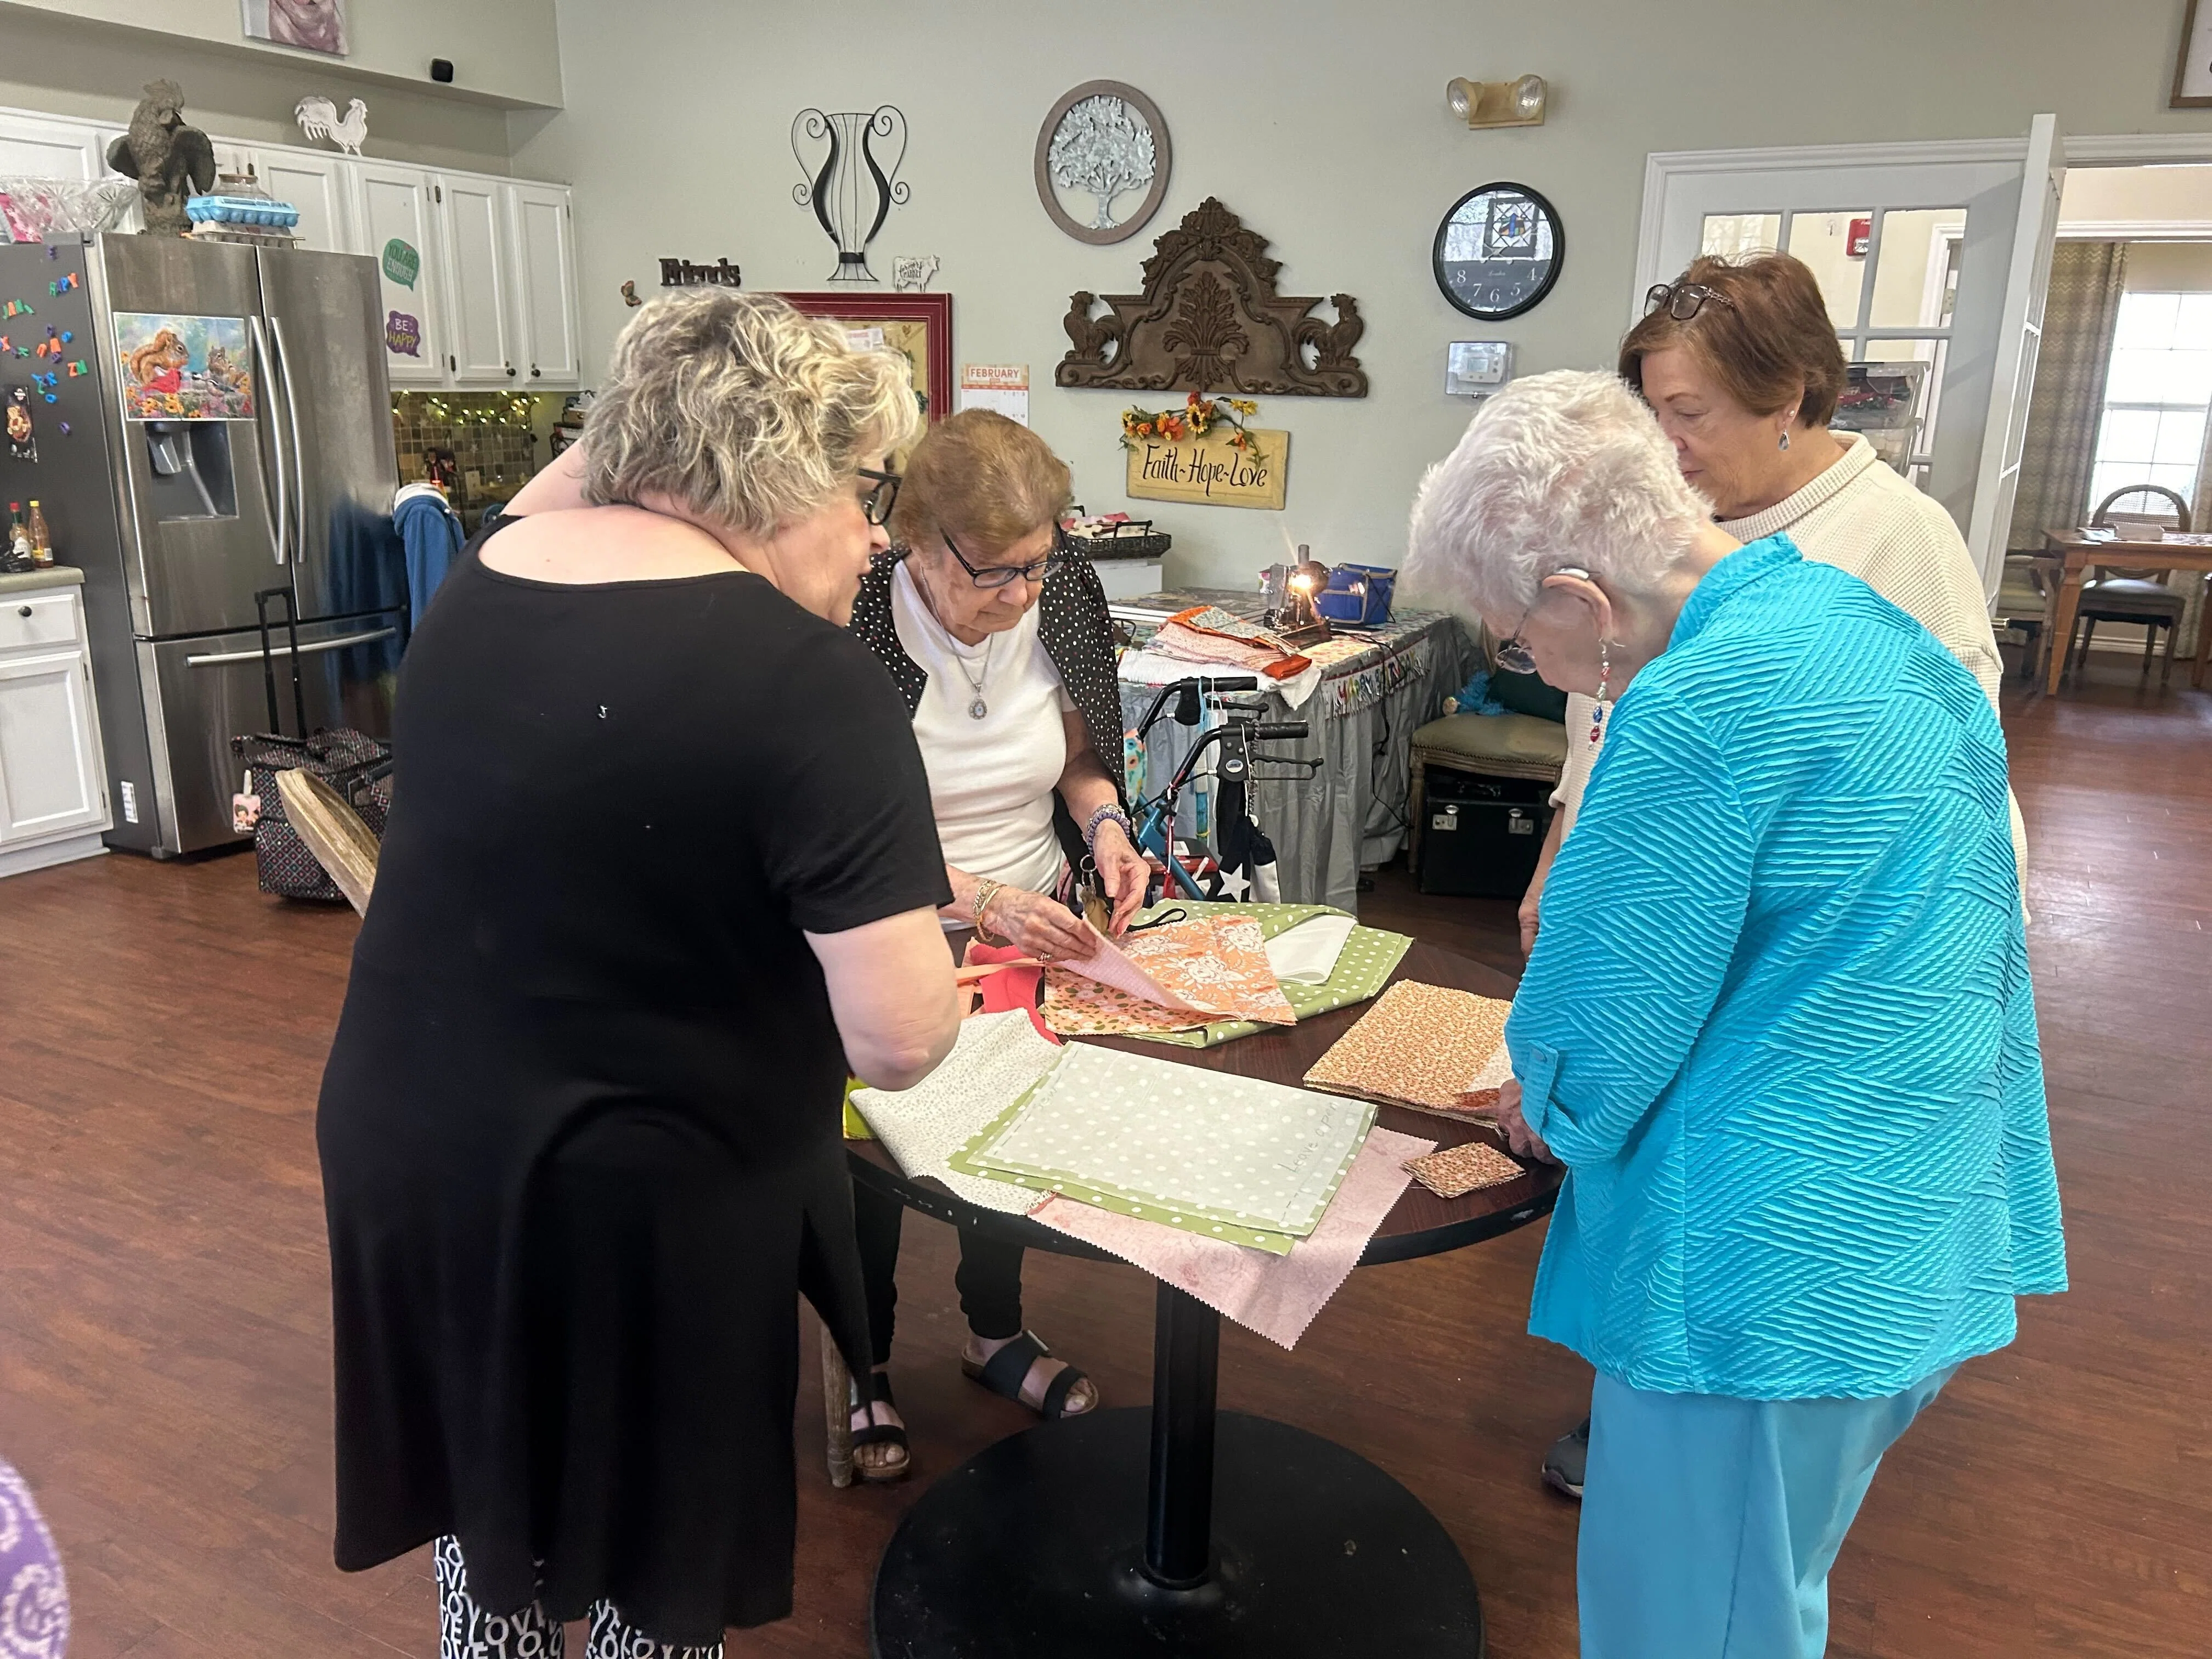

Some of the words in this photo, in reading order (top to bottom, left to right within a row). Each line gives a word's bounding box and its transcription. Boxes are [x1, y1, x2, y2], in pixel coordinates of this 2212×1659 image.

[386, 258, 414, 282] ENOUGH
[1527, 268, 1537, 281] 4
[1457, 270, 1466, 284] 8
[1473, 283, 1482, 297] 7
[1490, 289, 1500, 302] 6
[1510, 283, 1521, 296] 5
[388, 330, 417, 347] HAPPY
[970, 368, 1020, 378] FEBRUARY
